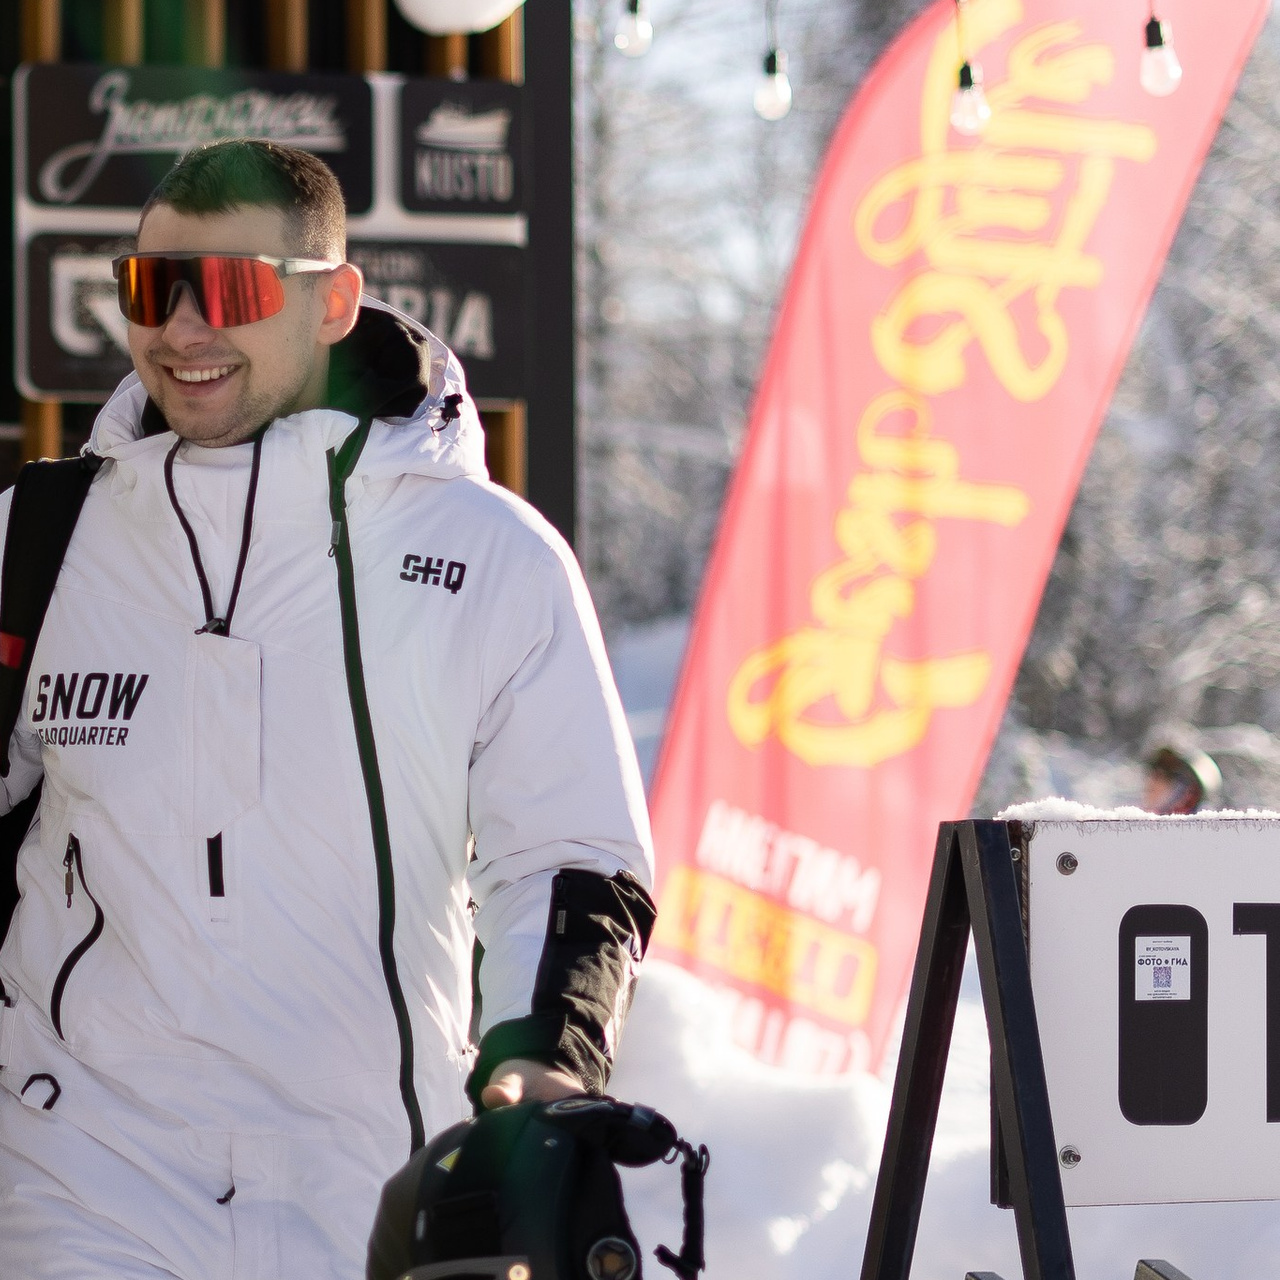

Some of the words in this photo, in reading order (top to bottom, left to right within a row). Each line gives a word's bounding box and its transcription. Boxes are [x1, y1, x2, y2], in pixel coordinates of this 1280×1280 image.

[31, 672, 150, 723] SNOW
[35, 726, 129, 747] EADQUARTER
[1137, 958, 1162, 966] ФОТО
